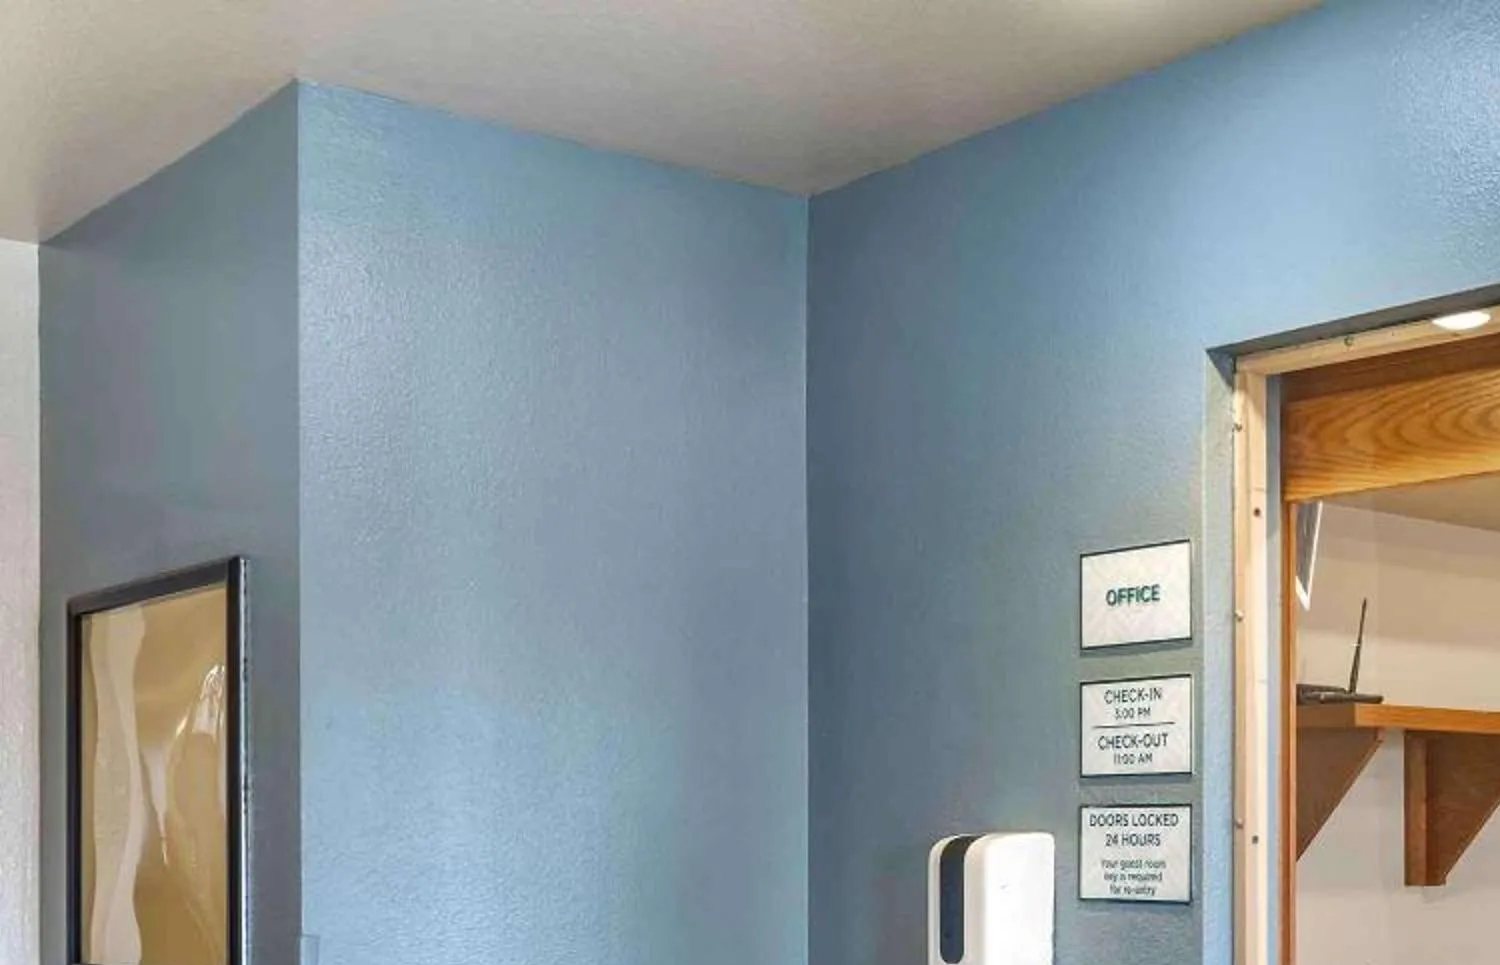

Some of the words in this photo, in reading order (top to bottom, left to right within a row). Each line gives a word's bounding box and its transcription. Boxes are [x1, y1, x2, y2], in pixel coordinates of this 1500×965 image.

[1105, 584, 1161, 606] OFFICE
[1104, 687, 1162, 704] CHECK-IN
[1138, 706, 1151, 717] PM
[1098, 733, 1168, 750] CHECK-OUT
[1113, 753, 1135, 765] 11:00
[1138, 753, 1153, 763] AM
[1089, 814, 1129, 827] DOORS
[1131, 813, 1179, 827] LOCKED
[1105, 834, 1118, 847] 24
[1121, 834, 1161, 847] HOURS
